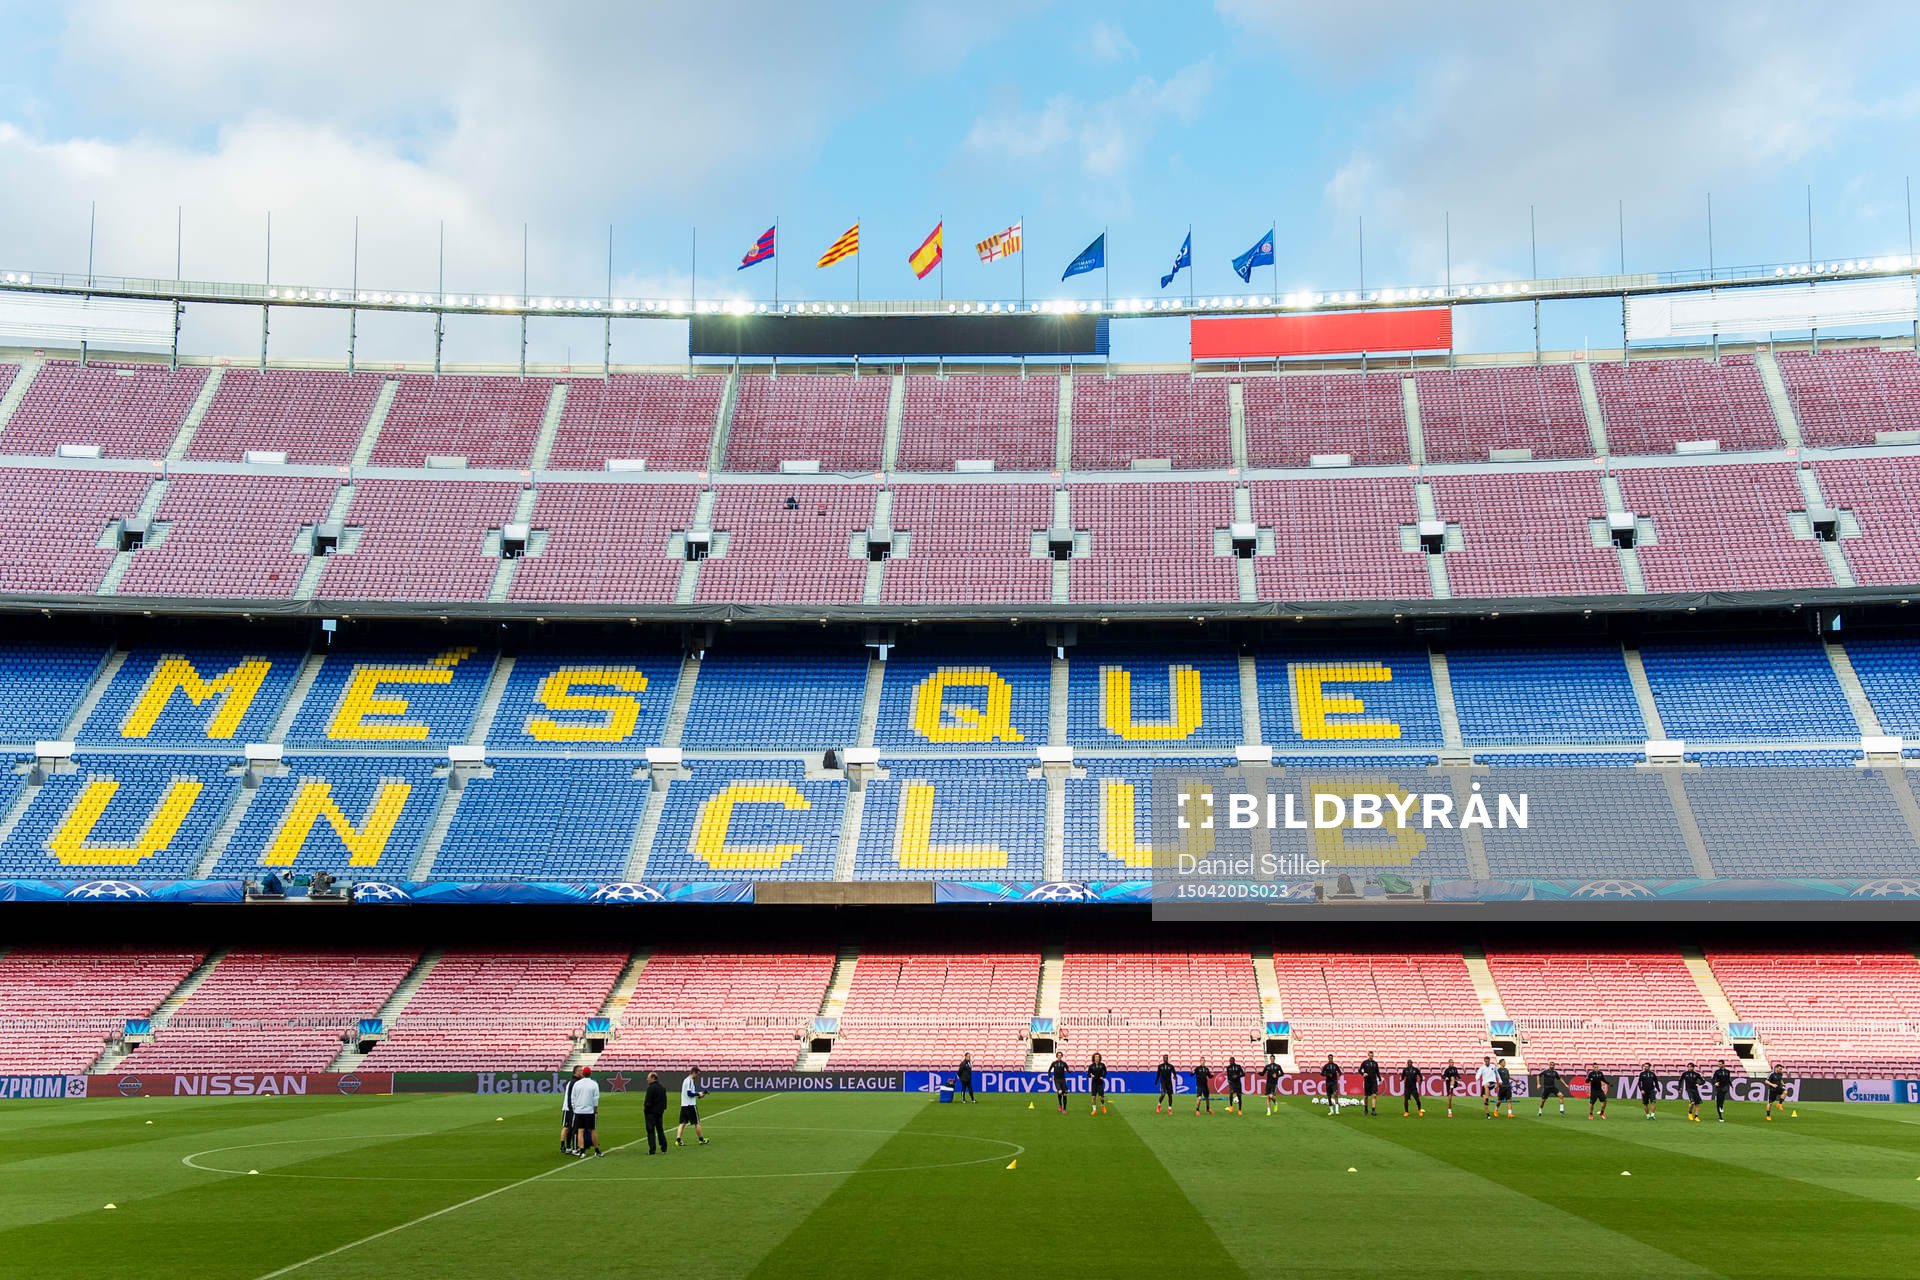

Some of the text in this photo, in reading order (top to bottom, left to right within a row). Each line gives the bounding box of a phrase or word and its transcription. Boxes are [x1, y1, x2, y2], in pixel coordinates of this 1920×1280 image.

[119, 646, 1401, 742] MÉS QUE
[44, 775, 1427, 869] UN CLUB
[0, 1077, 61, 1098] ZPROM
[174, 1075, 307, 1095] NISSAN
[476, 1073, 568, 1094] Heinek
[700, 1077, 896, 1089] UEFA CHAMPIONS LEAGUE
